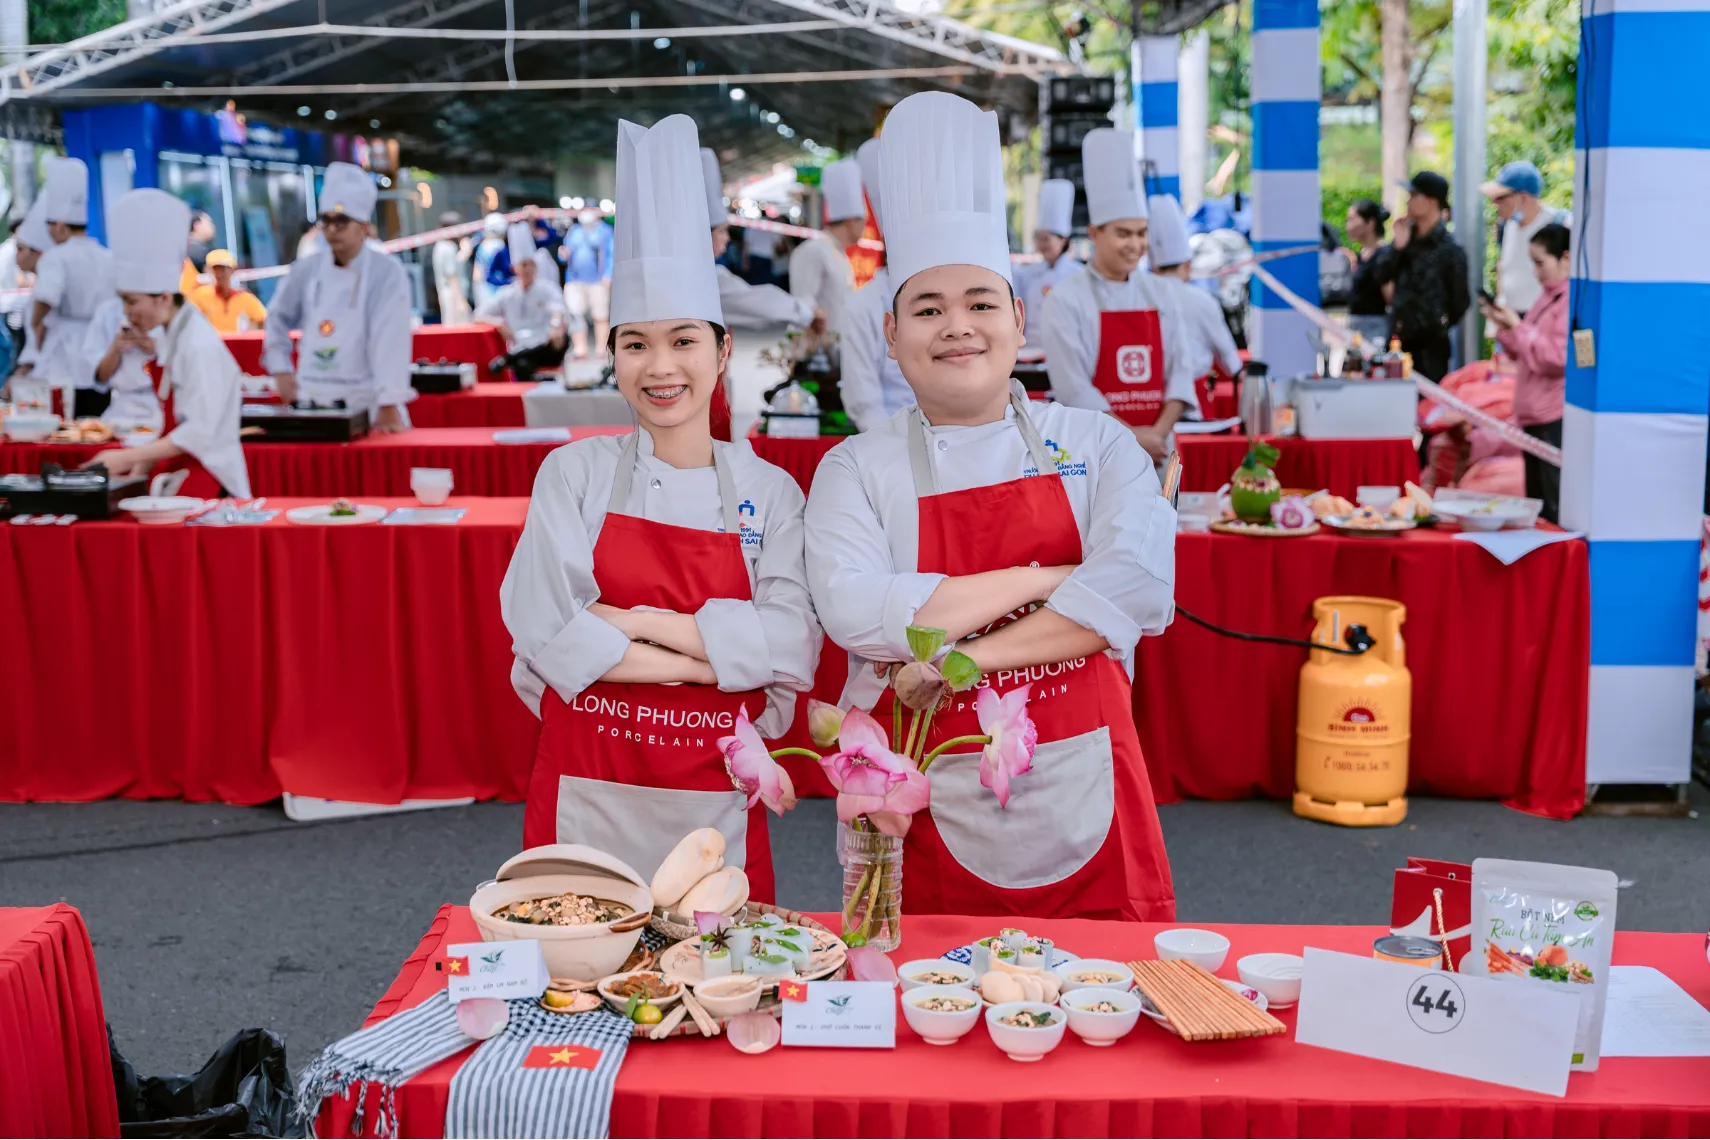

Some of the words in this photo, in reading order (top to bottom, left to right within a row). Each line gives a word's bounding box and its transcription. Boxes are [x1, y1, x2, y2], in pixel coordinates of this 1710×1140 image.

[572, 694, 630, 719] LONG
[636, 705, 733, 729] PHUONG
[597, 725, 704, 747] PORCELAIN
[1411, 984, 1458, 1019] 44
